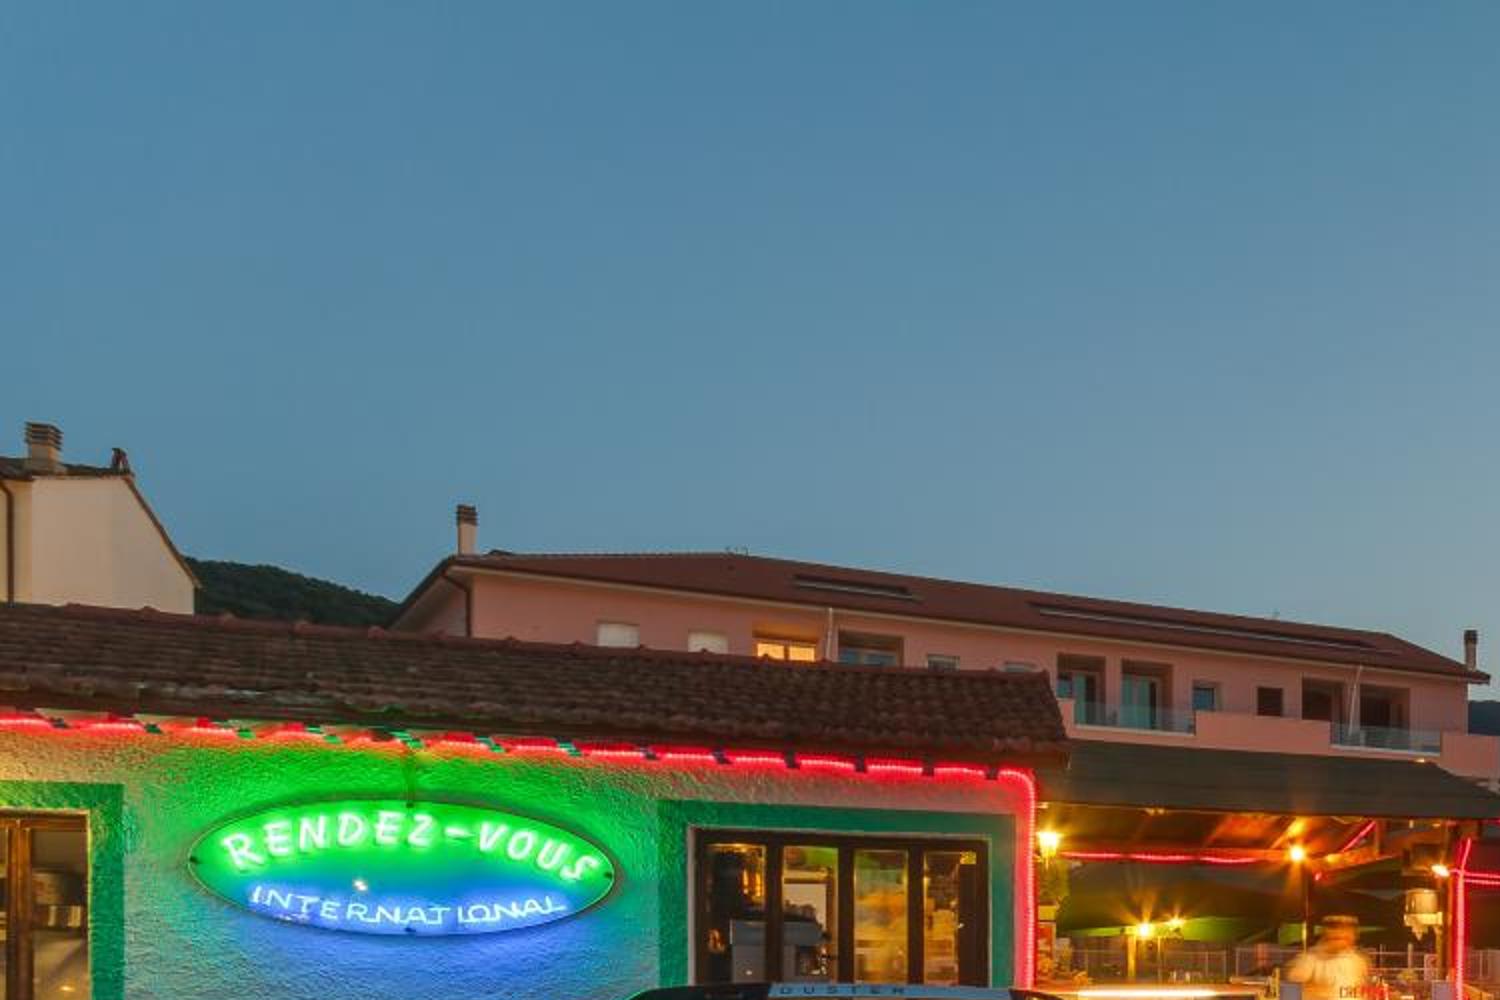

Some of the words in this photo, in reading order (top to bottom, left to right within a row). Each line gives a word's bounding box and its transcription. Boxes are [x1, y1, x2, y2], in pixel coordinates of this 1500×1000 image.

[221, 809, 599, 882] RENDEZ-VOUS
[249, 884, 567, 925] INTERNATIONAL
[779, 984, 905, 995] DUSTER
